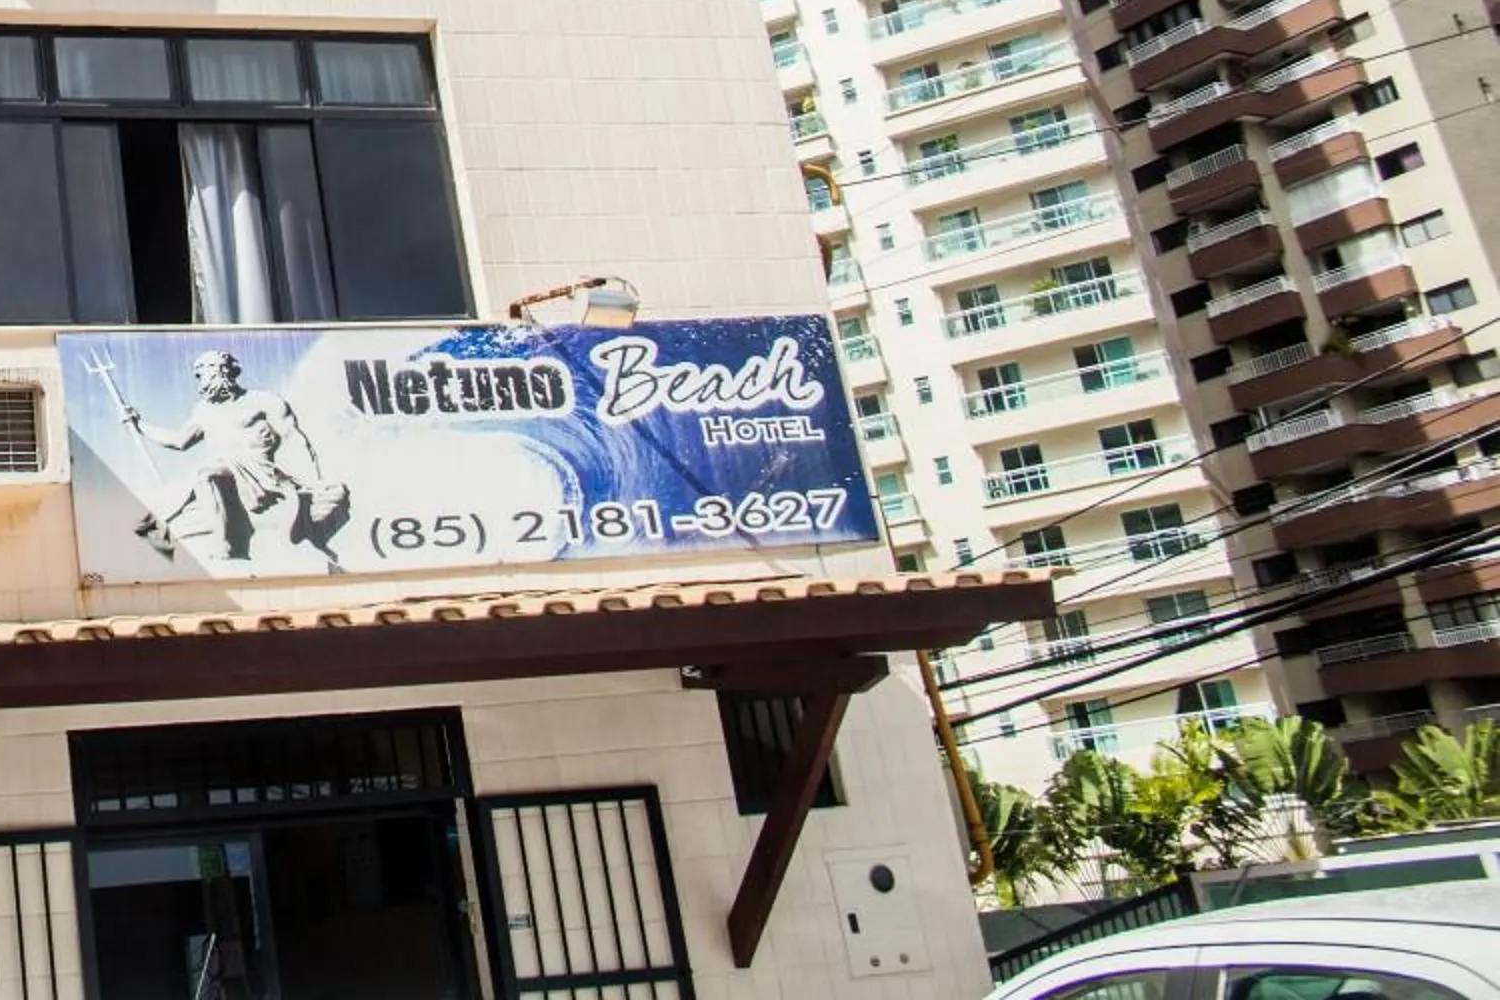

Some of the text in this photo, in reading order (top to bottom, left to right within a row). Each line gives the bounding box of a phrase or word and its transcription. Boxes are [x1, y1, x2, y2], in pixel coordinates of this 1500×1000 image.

[343, 342, 818, 418] Netuno Beach
[703, 417, 822, 443] HOTEL
[370, 490, 846, 559] (85) 2181-3627
